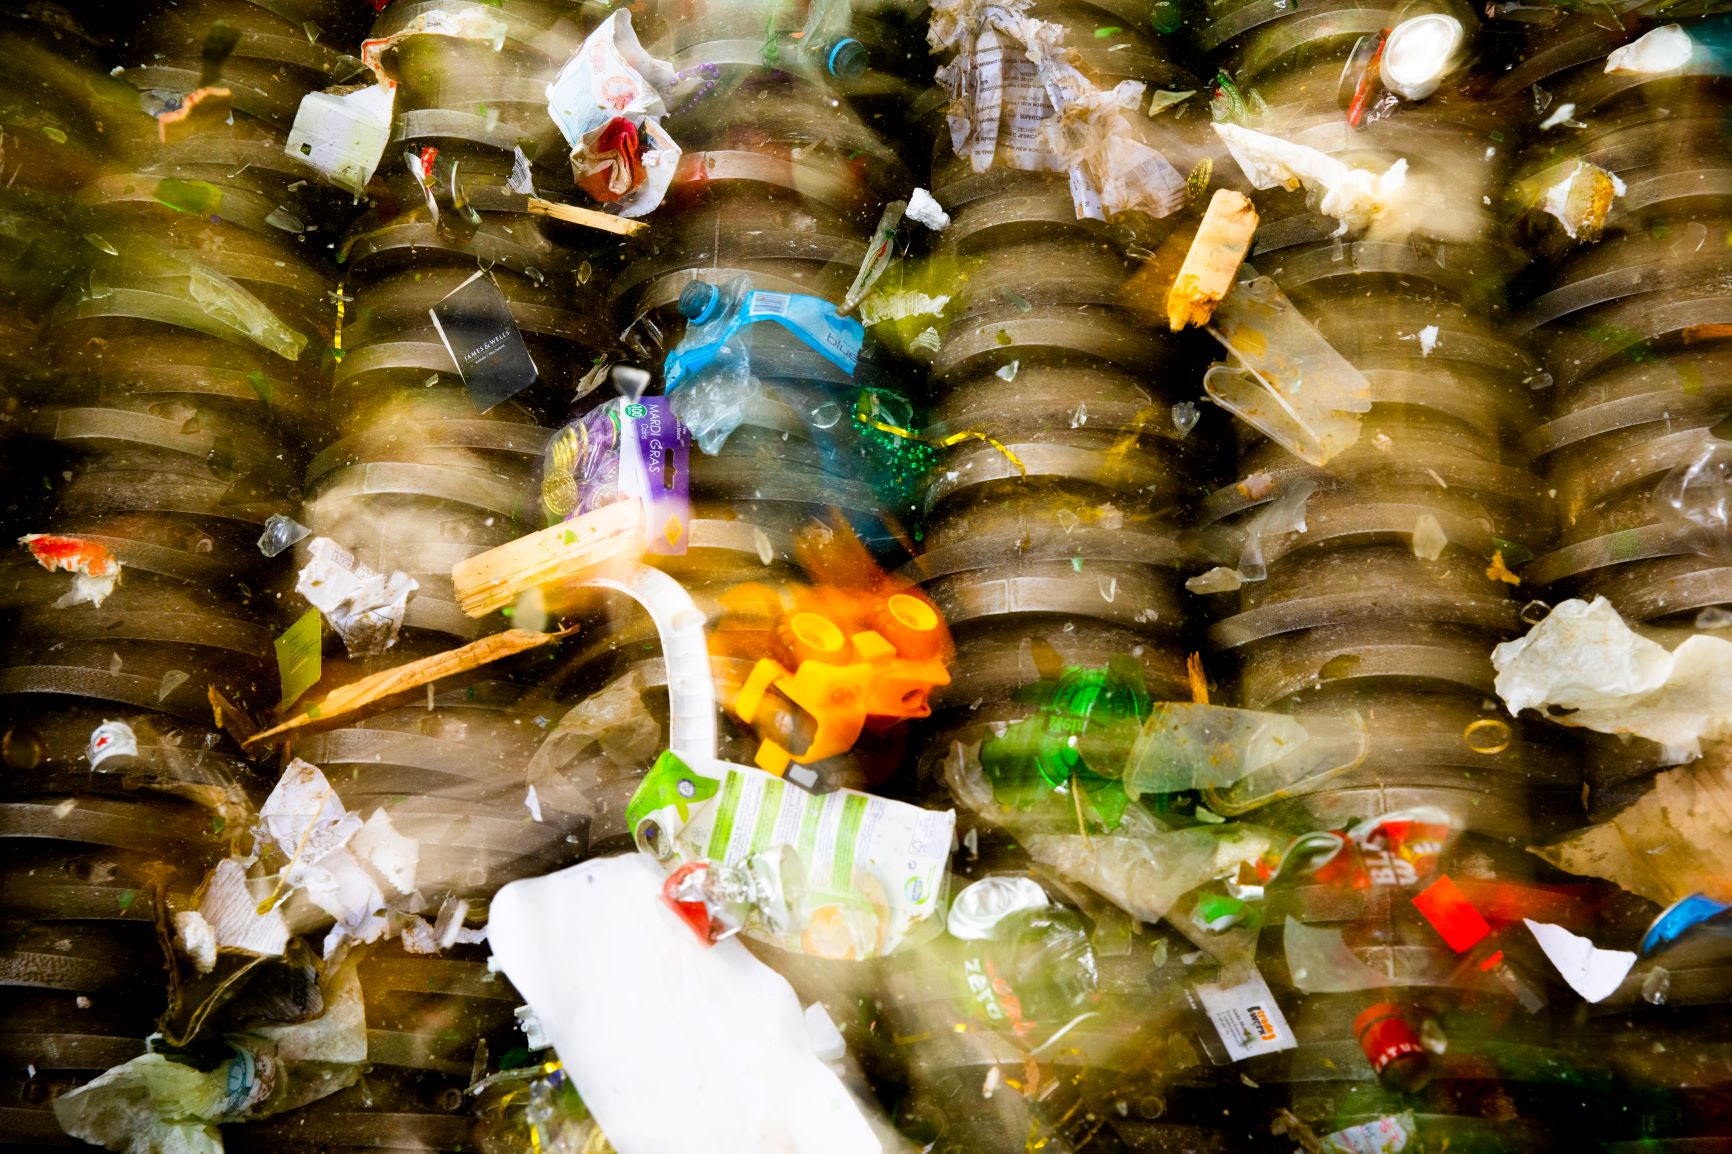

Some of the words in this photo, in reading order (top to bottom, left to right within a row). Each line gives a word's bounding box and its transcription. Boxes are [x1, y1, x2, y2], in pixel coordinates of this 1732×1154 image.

[464, 346, 484, 362] JAMES
[490, 330, 511, 345] WELLS
[649, 404, 661, 436] MARDI
[649, 438, 663, 473] GRAS
